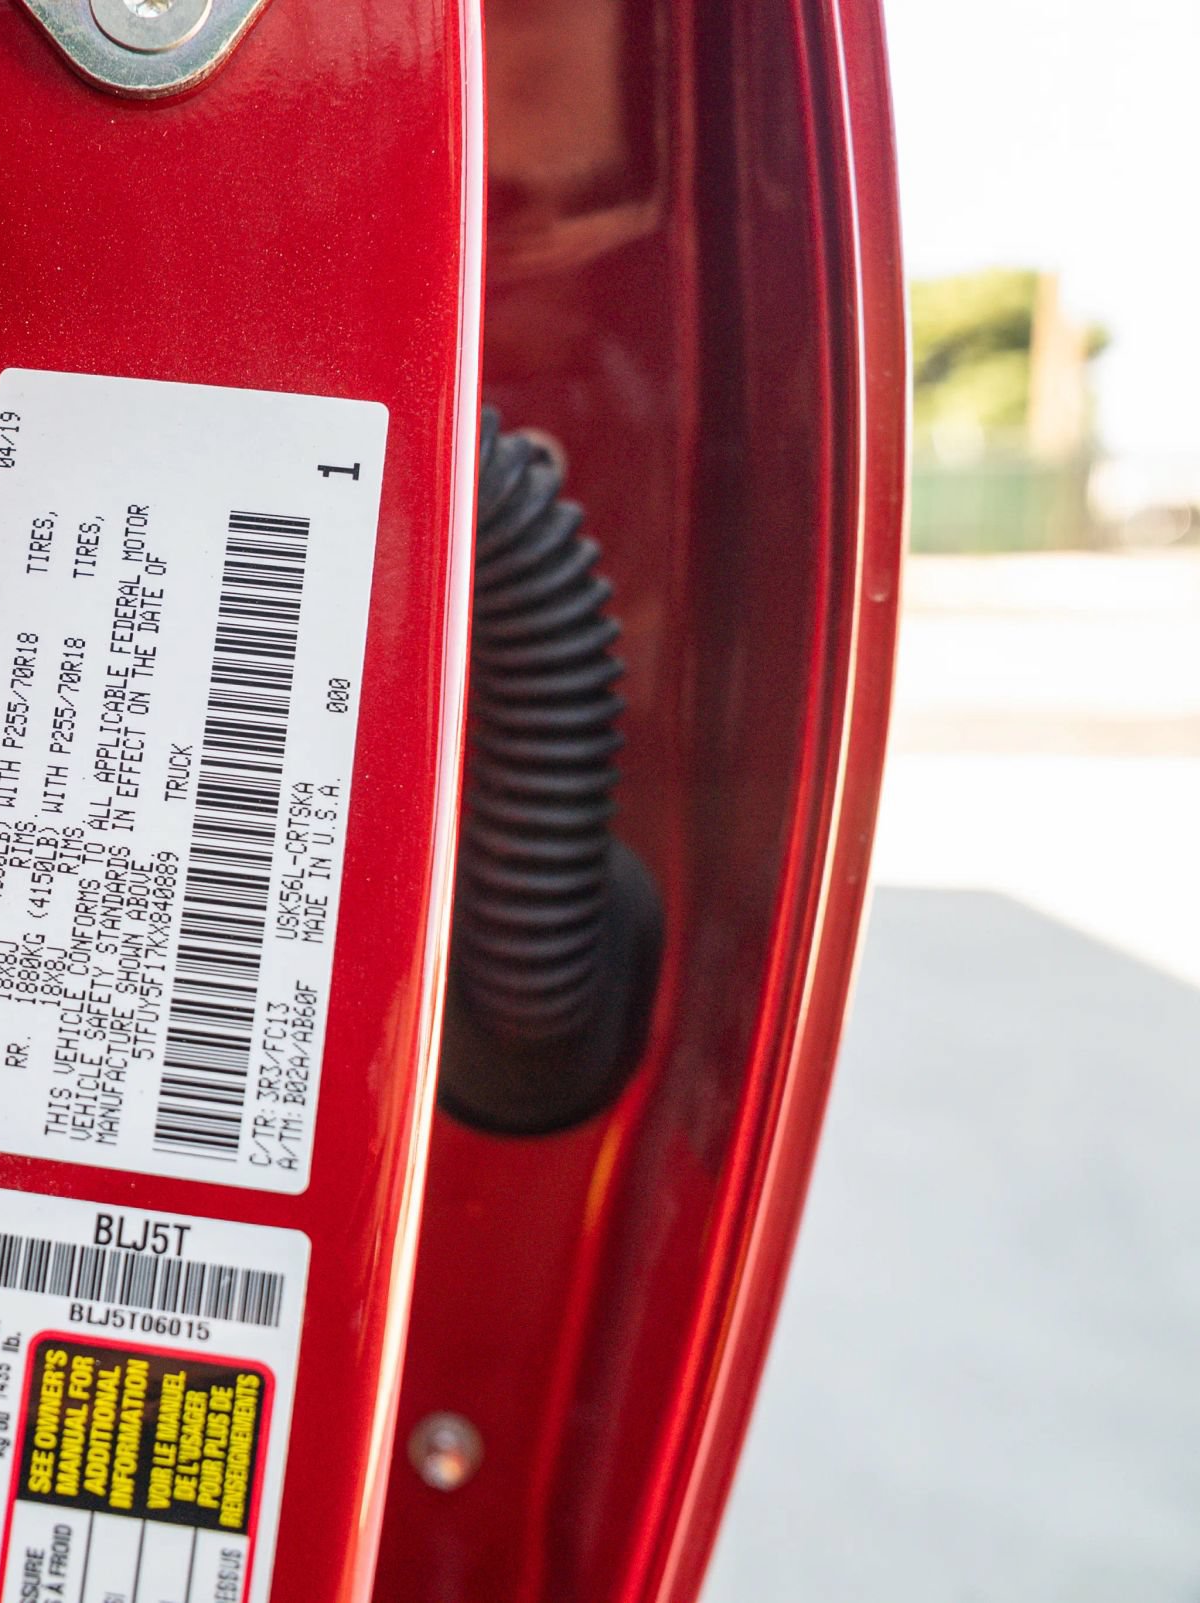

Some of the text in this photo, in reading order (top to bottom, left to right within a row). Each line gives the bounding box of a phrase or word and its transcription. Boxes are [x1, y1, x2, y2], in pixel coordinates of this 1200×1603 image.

[317, 462, 361, 481] 1
[1, 632, 39, 749] P255/70R18
[26, 511, 58, 574] TIRES,
[325, 677, 351, 714] 000
[4, 516, 104, 1069] RR. 1880KG (4150LB) WITH P255/70R18 TIRES,
[8, 814, 38, 870] RIMS.
[44, 504, 150, 1136] THIS VEHICLE CONFORMS TO ALL APPLICABLE FEDERAL MOTOR
[71, 552, 167, 1141] VEHICLE SAFETY STANDARDS IN EFFECT ON THE DATE OF
[312, 778, 341, 846] U.S.A.
[39, 820, 86, 1007] 18X8J RIMS.
[131, 743, 193, 1060] 5TFUY5F17KX840889 TRUCK
[275, 782, 314, 940] USK56L-CRTSKA
[301, 893, 328, 944] MADE
[307, 856, 332, 880] IN
[95, 854, 155, 1145] MANUFACTURE SHOWN ABOVE.
[93, 1213, 191, 1257] BLJ5T
[1, 1332, 21, 1353] lb.
[69, 1303, 210, 1341] BLJ5T06015
[28, 1349, 68, 1493] SEE OWNER'S
[55, 1355, 95, 1496] MANUAL FOR
[84, 1365, 121, 1496] ADDITIONAL
[109, 1359, 149, 1509] INFORMATION
[147, 1370, 186, 1508] VOIR LE MANUEL
[173, 1390, 207, 1501] DE L'USAGER
[197, 1385, 234, 1508] POUR PLUS DE
[219, 1374, 260, 1527] RENSEIGNEMENTS
[48, 1524, 72, 1578] FROID
